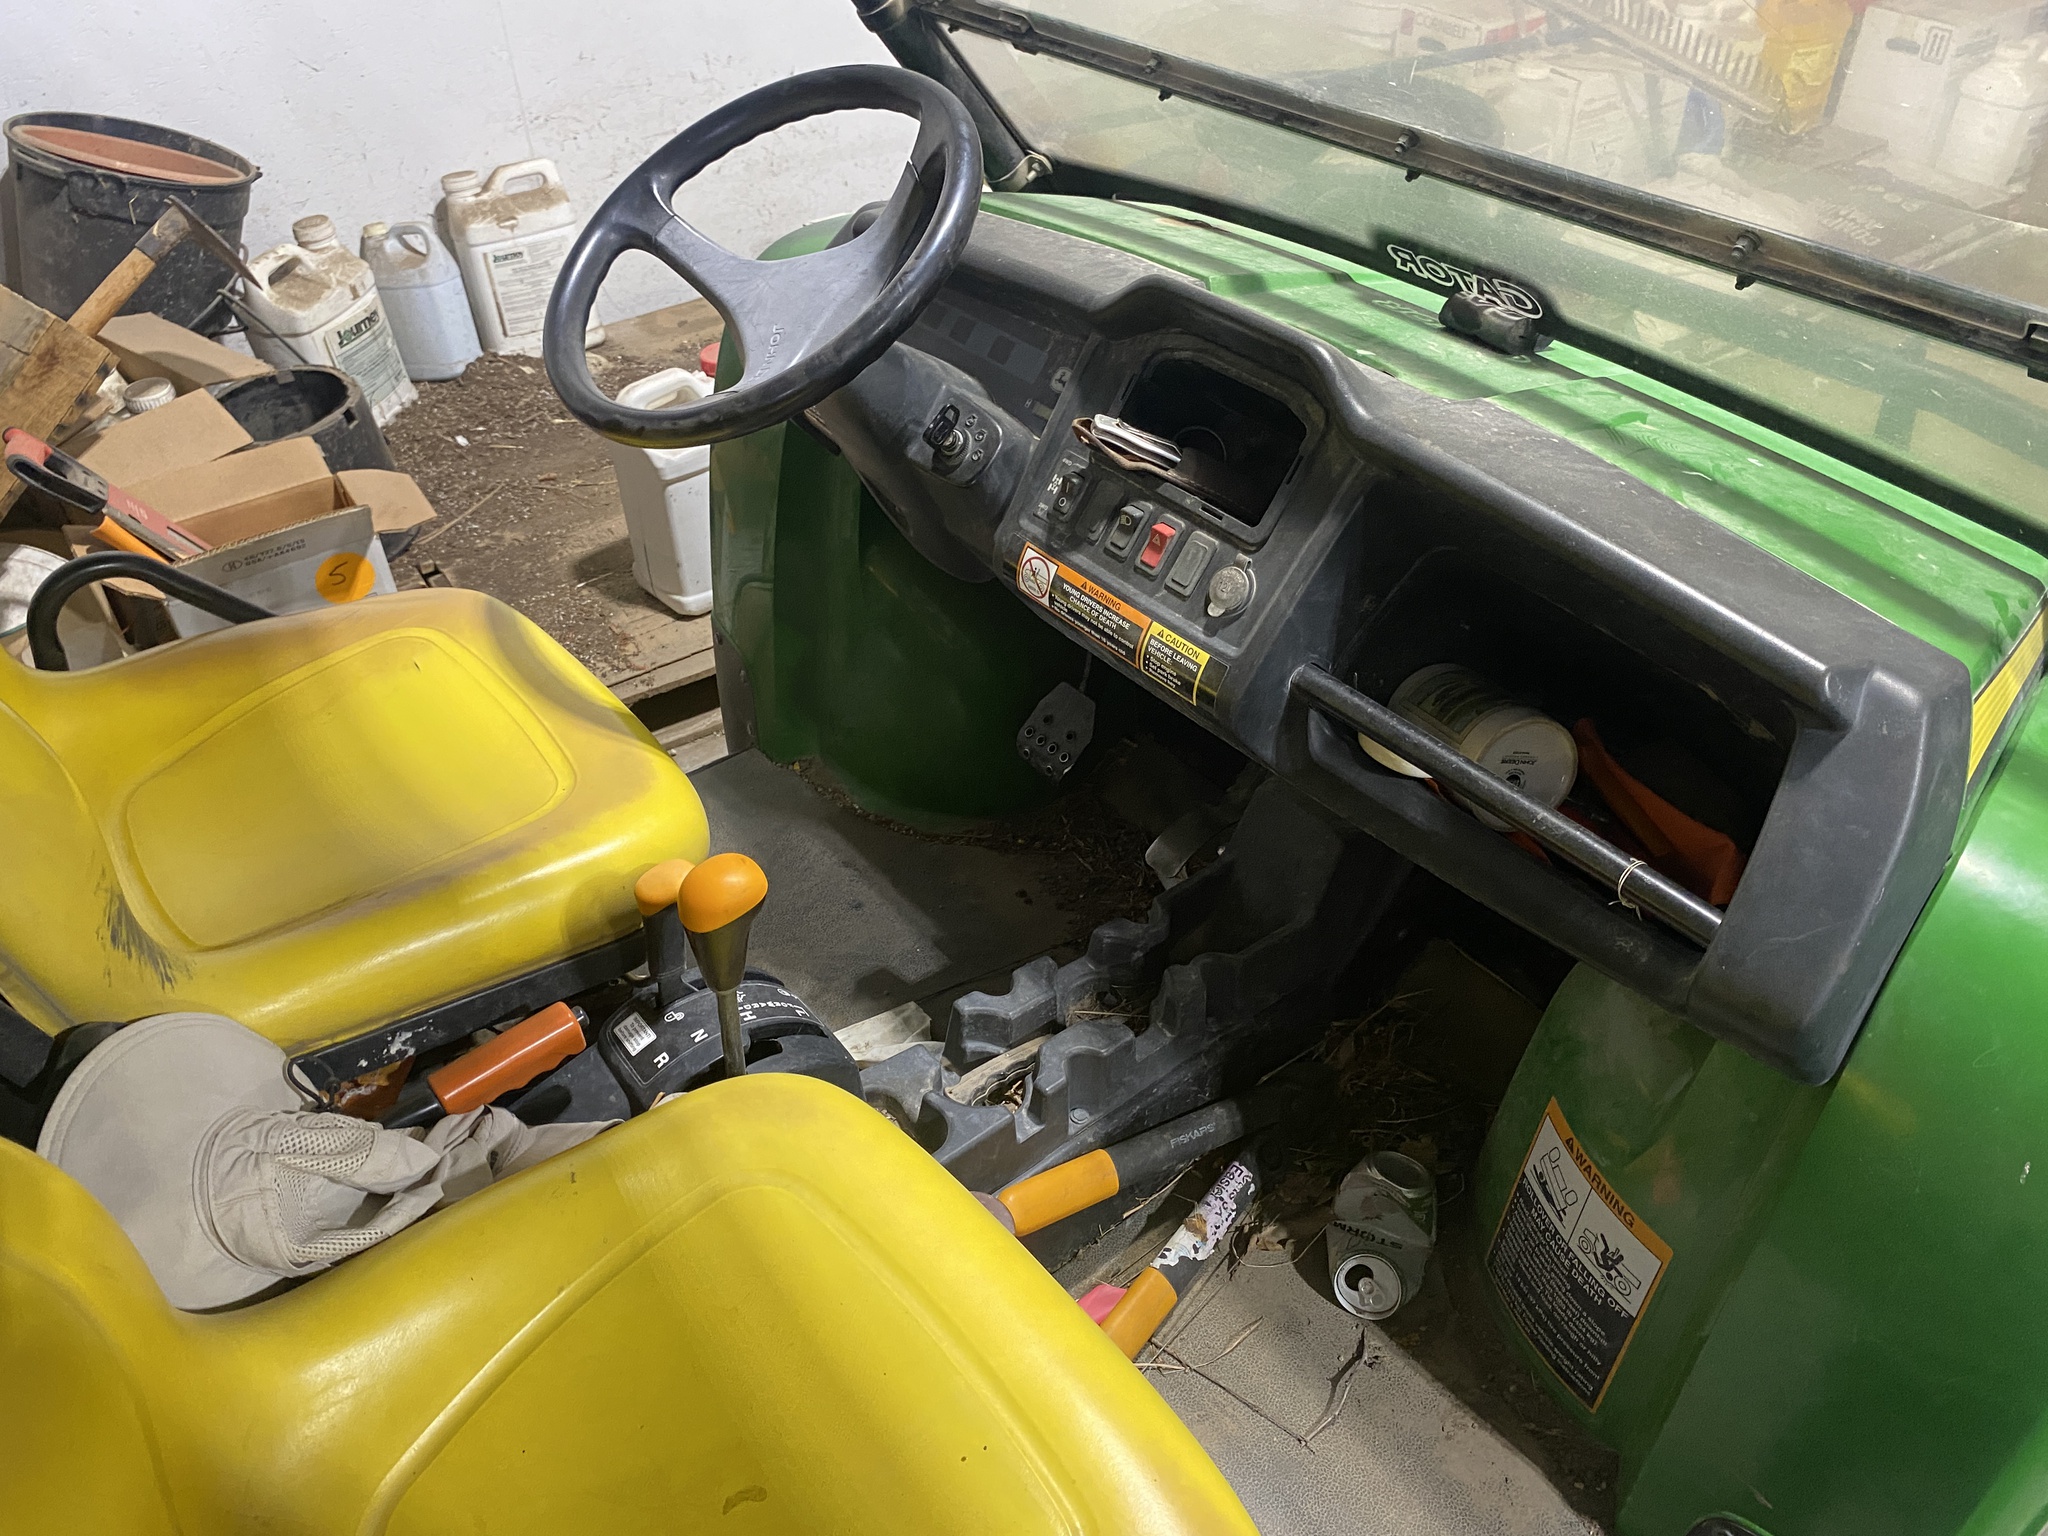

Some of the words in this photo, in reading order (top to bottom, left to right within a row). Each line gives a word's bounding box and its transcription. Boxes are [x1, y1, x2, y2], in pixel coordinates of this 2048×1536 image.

[1061, 583, 1080, 598] YOUNG
[1080, 594, 1103, 612] DRIVERS
[1102, 609, 1130, 629] INCREASE
[1087, 586, 1121, 610] WARNING
[1069, 595, 1091, 612] CHANCE
[1090, 609, 1098, 617] OF
[1098, 614, 1117, 629] DEATH
[1066, 603, 1081, 614] drivers
[1080, 613, 1090, 621] may
[1103, 627, 1113, 635] able
[1118, 636, 1134, 649] control
[1146, 645, 1173, 665] VEHICLE:
[1149, 638, 1173, 656] BEFORE
[1172, 653, 1198, 671] LEAVING
[1164, 633, 1199, 658] CAUTION
[1148, 662, 1157, 670] Set
[1156, 668, 1167, 676] park
[1167, 674, 1181, 685] brake
[1149, 656, 1161, 666] Stop
[1160, 663, 1177, 676] engine
[739, 1010, 758, 1021] H
[632, 1026, 644, 1040] prevent
[690, 1028, 709, 1043] N
[653, 1051, 670, 1068] R
[1576, 1147, 1634, 1228] WARNING
[1333, 1221, 1403, 1249] STORM
[1522, 1177, 1555, 1234] ROLLOVER
[1555, 1234, 1567, 1251] OR
[1568, 1251, 1605, 1297] FALLING
[1607, 1296, 1628, 1321] OFF
[1531, 1208, 1544, 1231] MAY
[1544, 1231, 1570, 1269] CAUSE
[1571, 1268, 1601, 1305] DEATH
[1566, 1290, 1581, 1310] down
